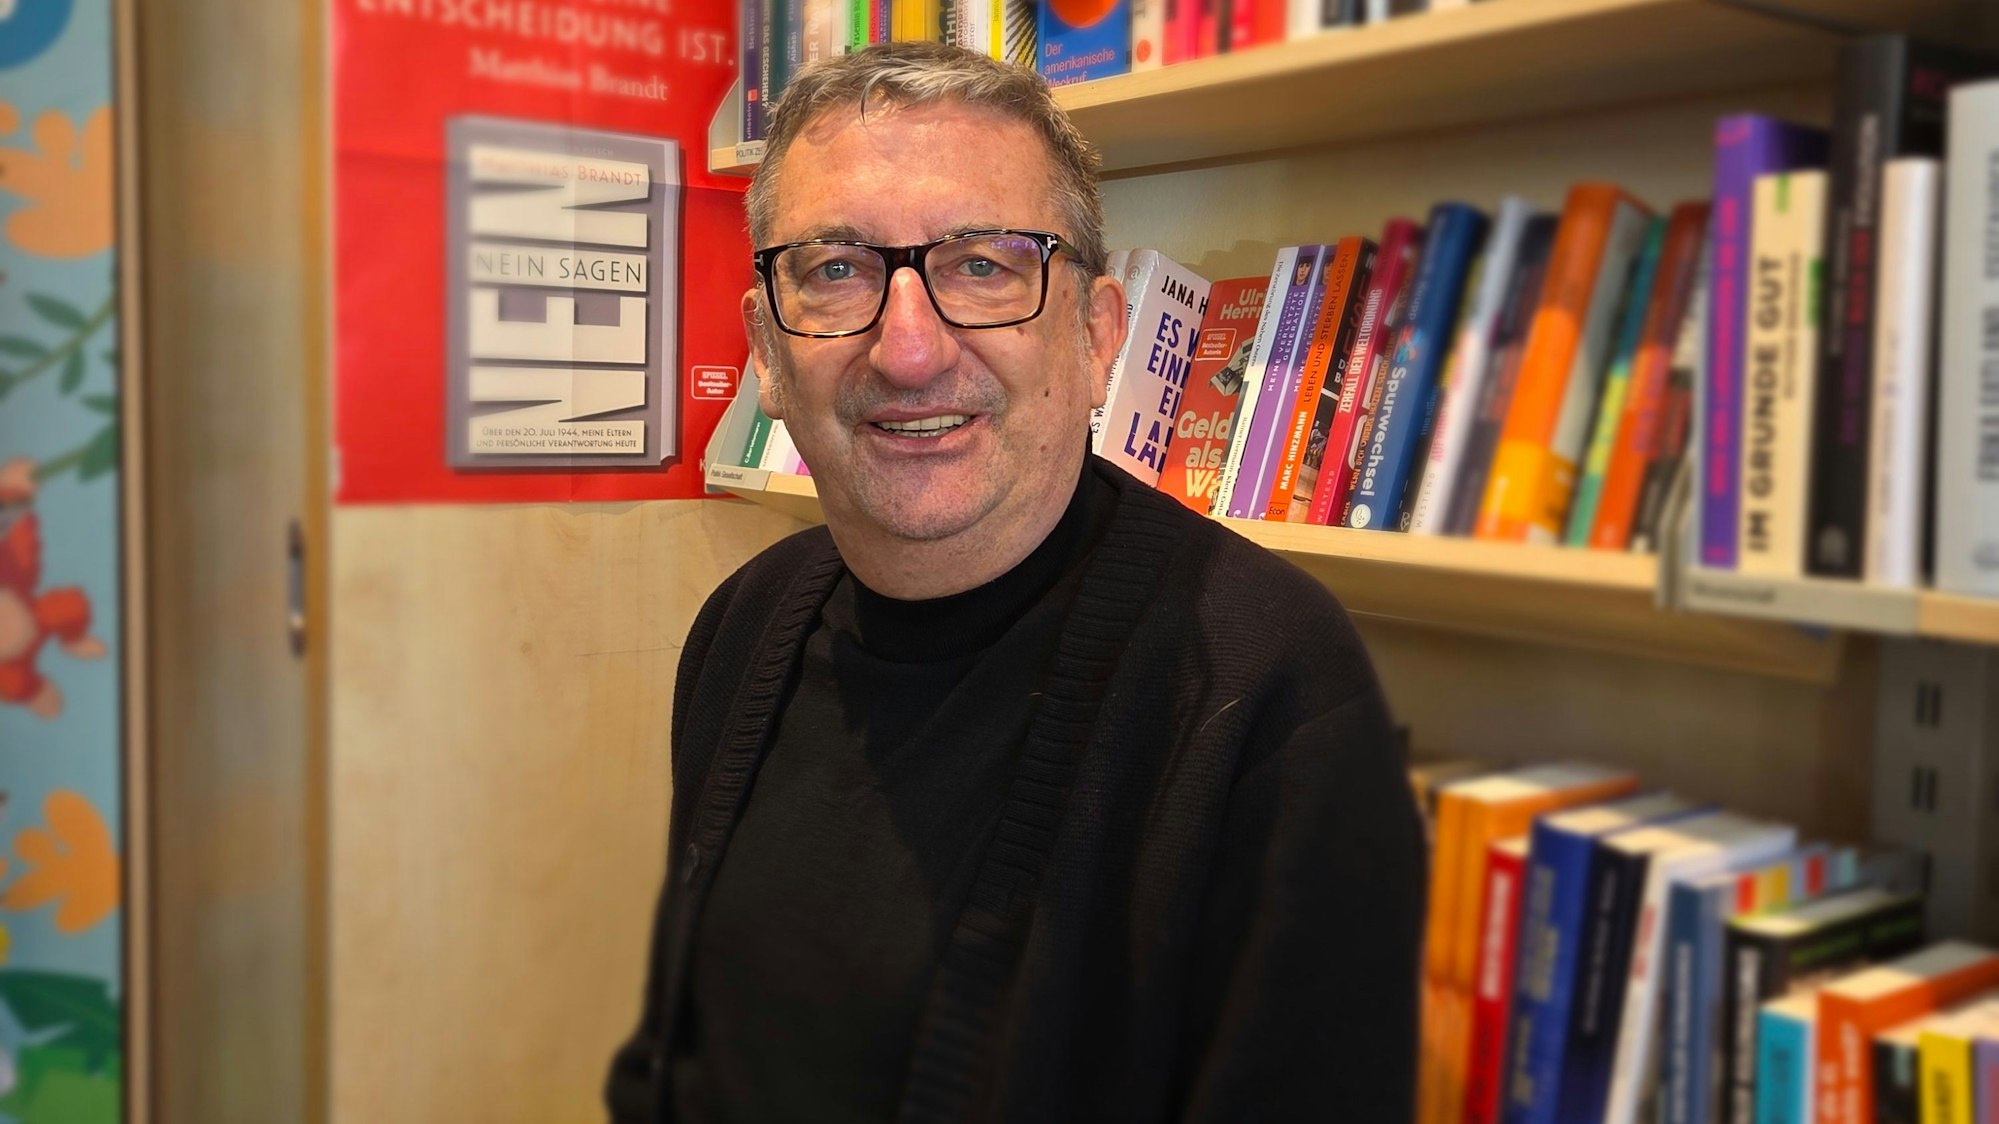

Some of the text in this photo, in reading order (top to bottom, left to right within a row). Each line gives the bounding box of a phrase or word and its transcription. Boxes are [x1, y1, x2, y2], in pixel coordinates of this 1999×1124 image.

[680, 28, 735, 66] IST.
[853, 12, 861, 48] Yasemin
[809, 41, 819, 62] ER
[1044, 48, 1115, 75] amerikanische
[1045, 43, 1063, 57] Der
[590, 64, 668, 101] Brandt
[761, 46, 770, 108] GESCHEHEN?
[475, 252, 642, 284] NEIN SAGEN
[1161, 275, 1209, 317] JANA H
[1239, 288, 1267, 306] Ulri
[1250, 260, 1284, 367] Die Zerstörung des Nahen Ostens
[1156, 312, 1183, 348] ES
[1282, 290, 1306, 361] GENERATION
[1353, 286, 1383, 355] WELTORDNUNG
[1267, 290, 1299, 391] MEINE VERLETZTE
[1147, 342, 1191, 389] EIN
[1279, 252, 1350, 490] MARC HINZMANN LEBEN UND STERBEN LASSEN
[1293, 358, 1306, 392] MEINE
[1348, 354, 1364, 376] DER
[1158, 385, 1181, 420] EI
[1338, 376, 1358, 414] ZERFALL
[1748, 255, 1785, 552] IM GRUNDE GUT
[476, 438, 638, 448] UND PERSÖNLICHE VERANTWORTUNG HEUTE
[505, 427, 522, 437] DEN
[523, 427, 537, 437] 20.
[558, 427, 580, 438] 1944,
[582, 427, 605, 438] MEINE
[606, 427, 632, 438] ELTERN
[1177, 410, 1235, 440] Geld
[1358, 364, 1407, 498] Spurwechsel
[1185, 440, 1223, 469] als
[1315, 468, 1335, 523] WESTEND
[1349, 468, 1361, 491] WENN
[1268, 506, 1286, 517] Econ
[1414, 471, 1436, 528] WESTEND
